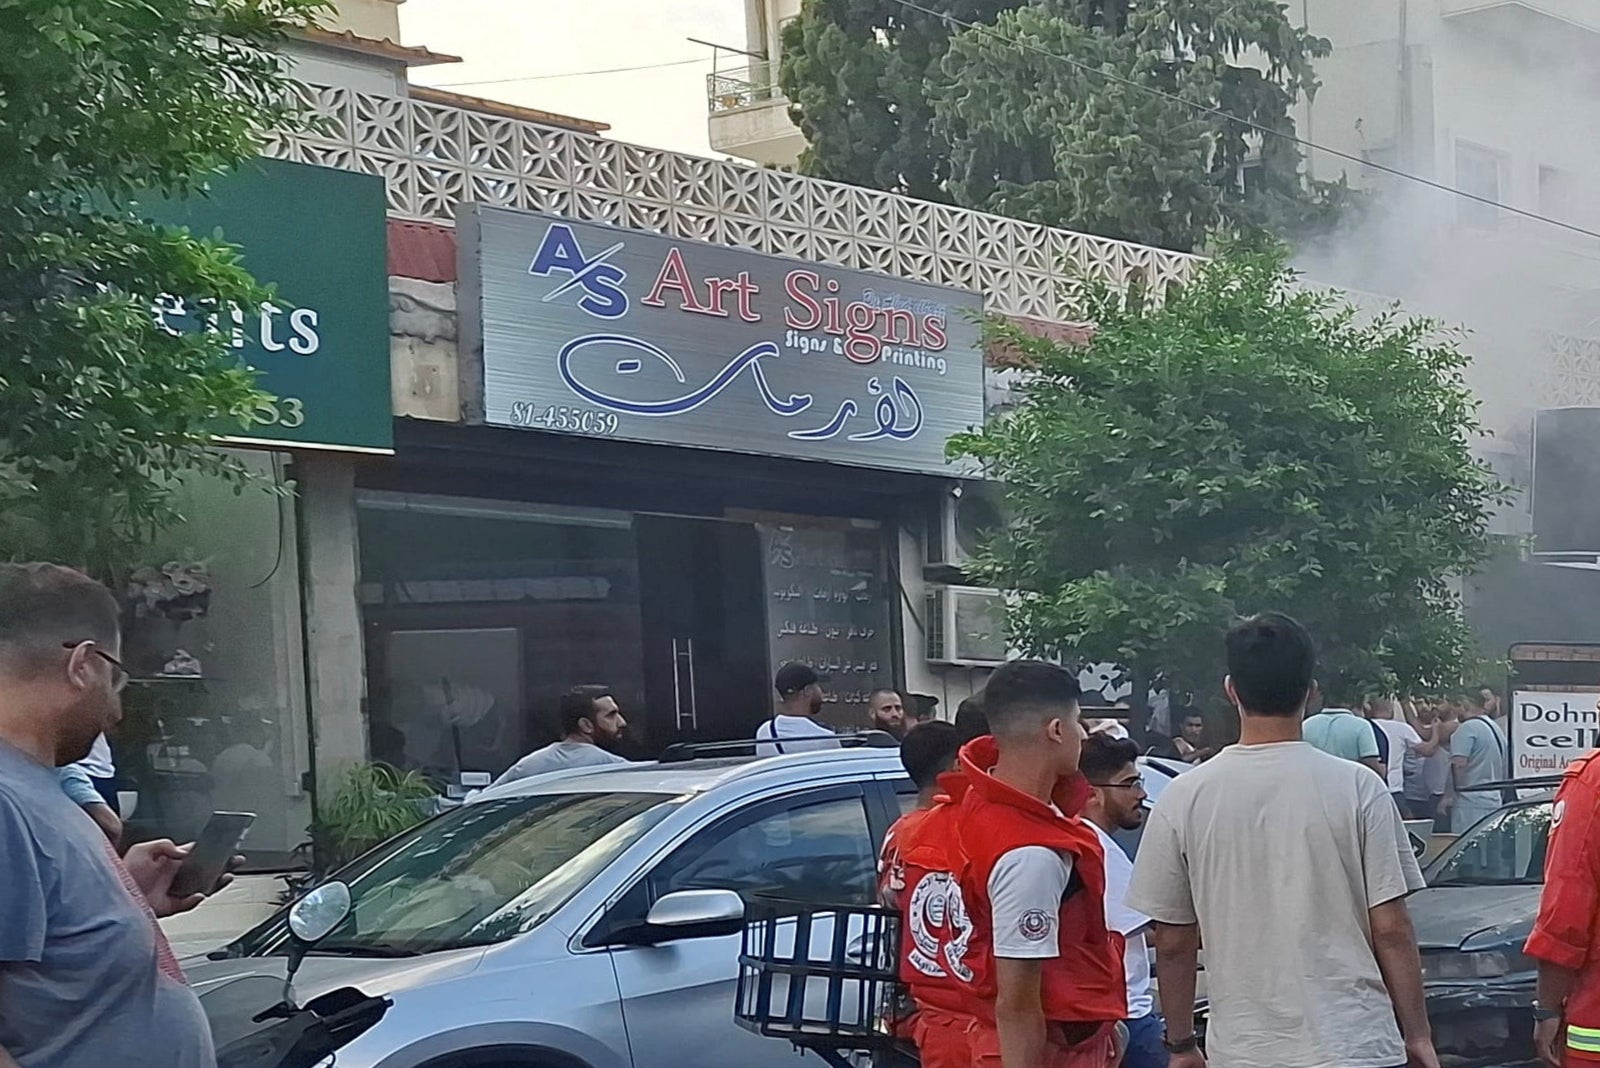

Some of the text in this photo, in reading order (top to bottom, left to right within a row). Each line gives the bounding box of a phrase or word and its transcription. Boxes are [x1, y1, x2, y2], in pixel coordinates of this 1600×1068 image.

[641, 247, 949, 364] Art Signs
[784, 330, 827, 355] Signs
[881, 345, 947, 375] Printing
[510, 400, 619, 434] 81-455059
[1519, 702, 1600, 724] Dohn
[1519, 753, 1557, 773] Original
